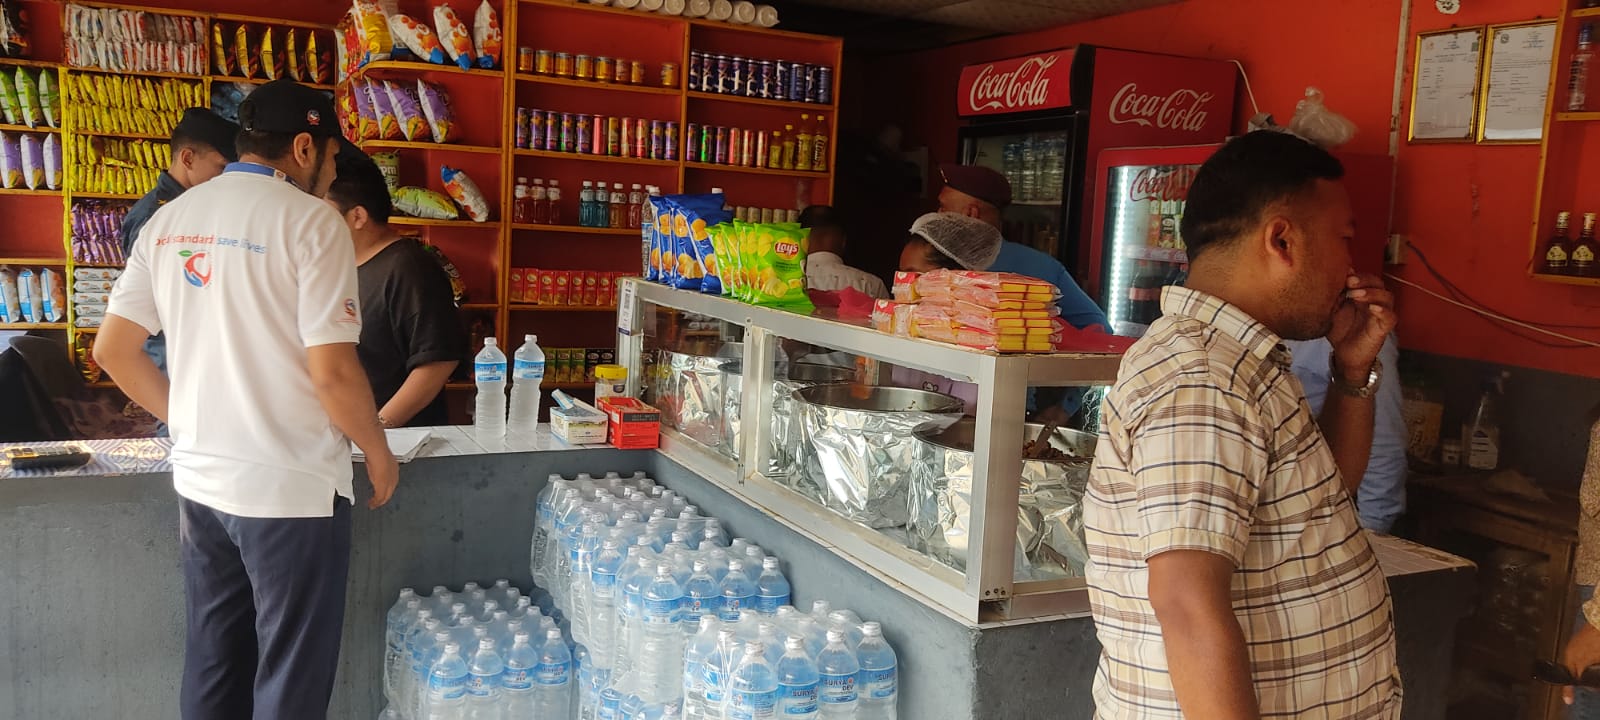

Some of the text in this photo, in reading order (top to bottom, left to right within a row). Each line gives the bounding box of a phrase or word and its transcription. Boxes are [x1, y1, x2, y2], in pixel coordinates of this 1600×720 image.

[970, 55, 1060, 112] Coca-Cola
[1108, 83, 1215, 132] Coca-Cola
[217, 236, 239, 247] save
[824, 678, 847, 686] SURYA
[842, 683, 854, 691] DEV
